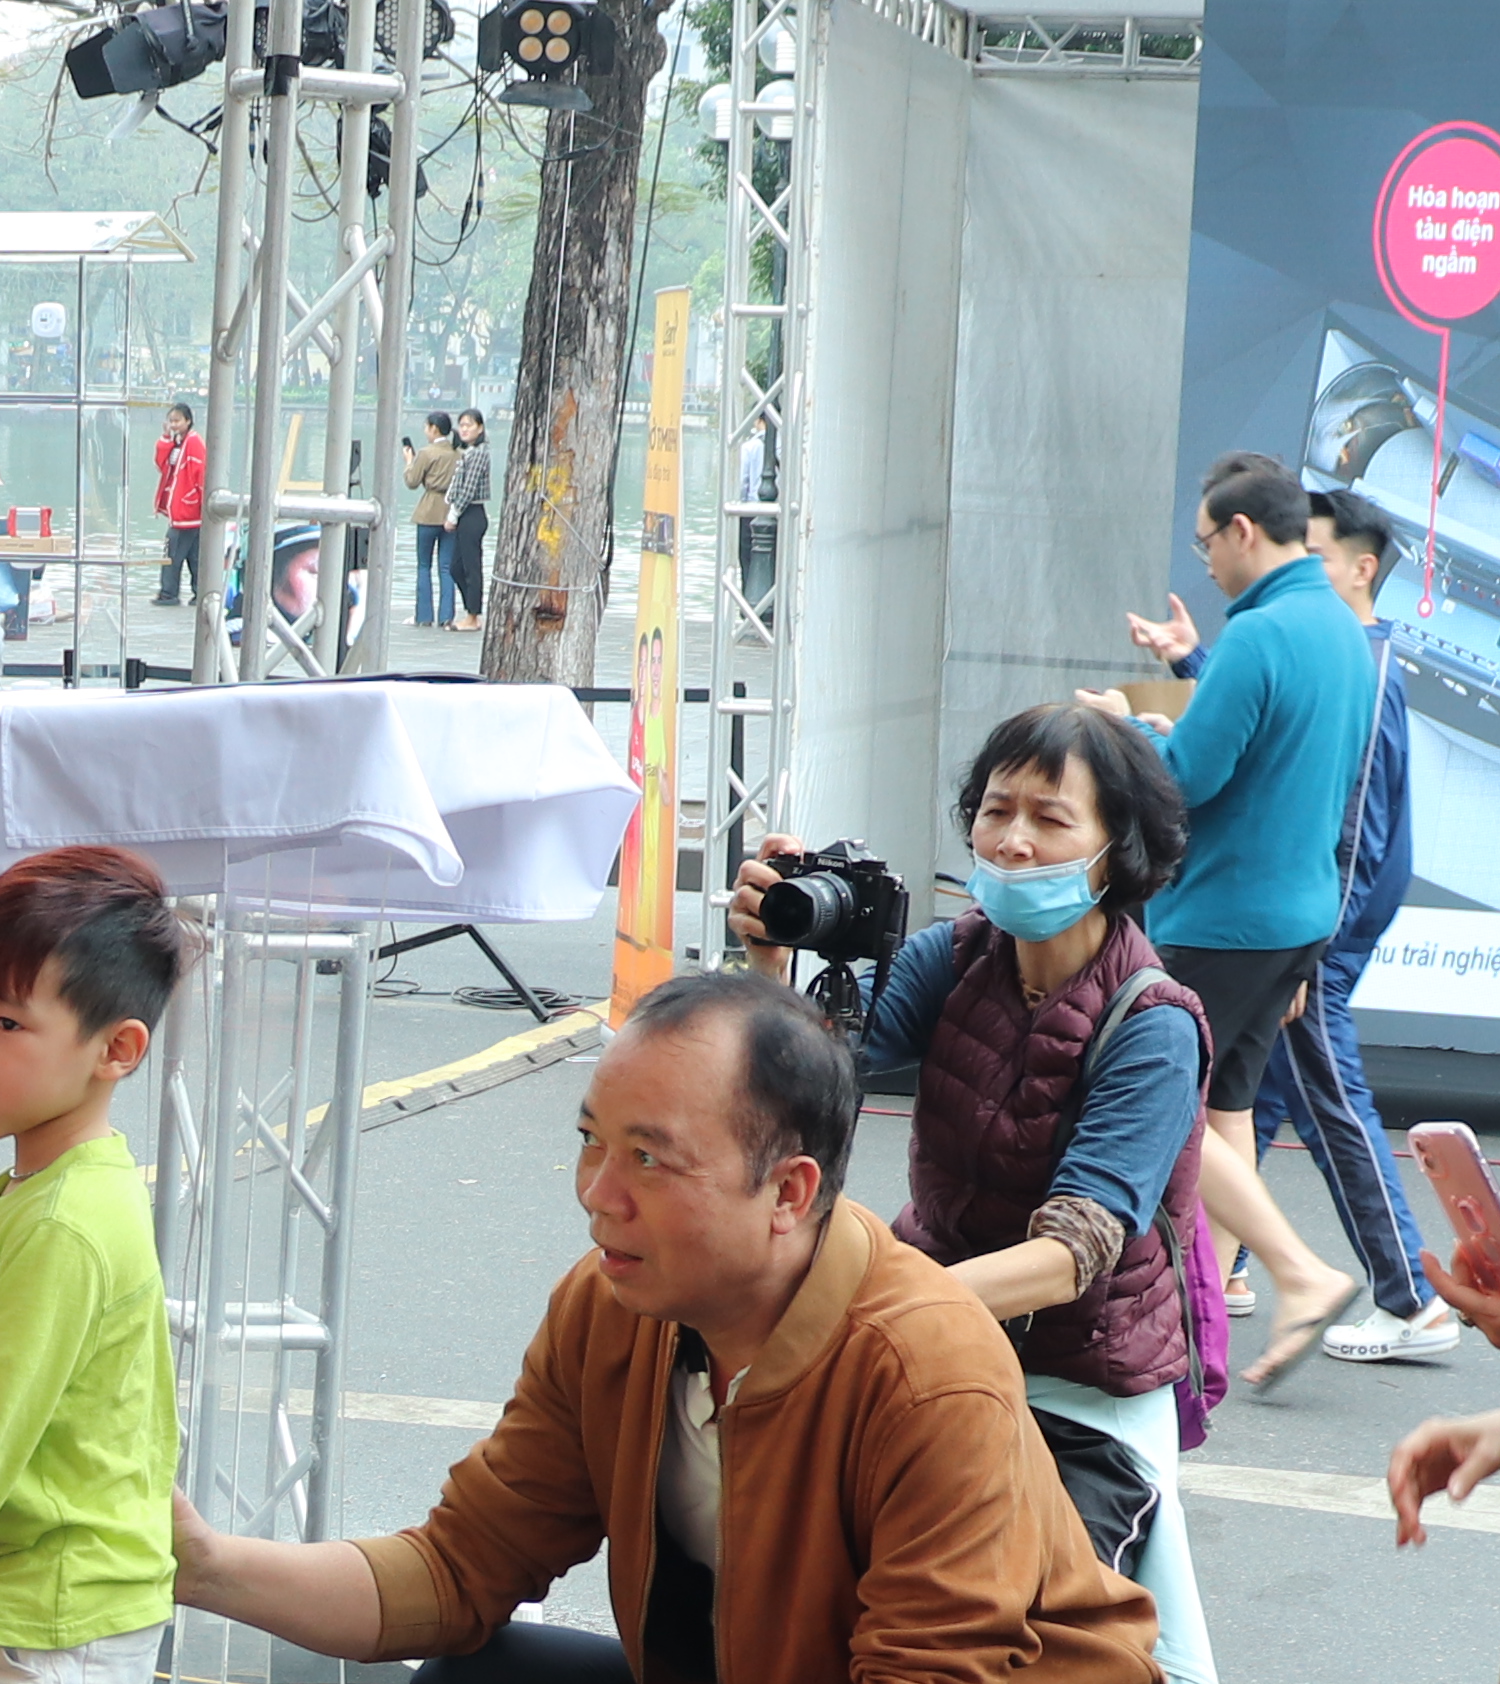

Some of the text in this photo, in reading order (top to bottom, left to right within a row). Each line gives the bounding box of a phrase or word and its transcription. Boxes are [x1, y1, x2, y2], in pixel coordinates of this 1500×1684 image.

[1451, 187, 1500, 215] hoạn
[1451, 218, 1494, 248] điện
[817, 857, 845, 868] Nikon
[1402, 943, 1437, 968] trải
[1340, 1344, 1389, 1355] crocs
